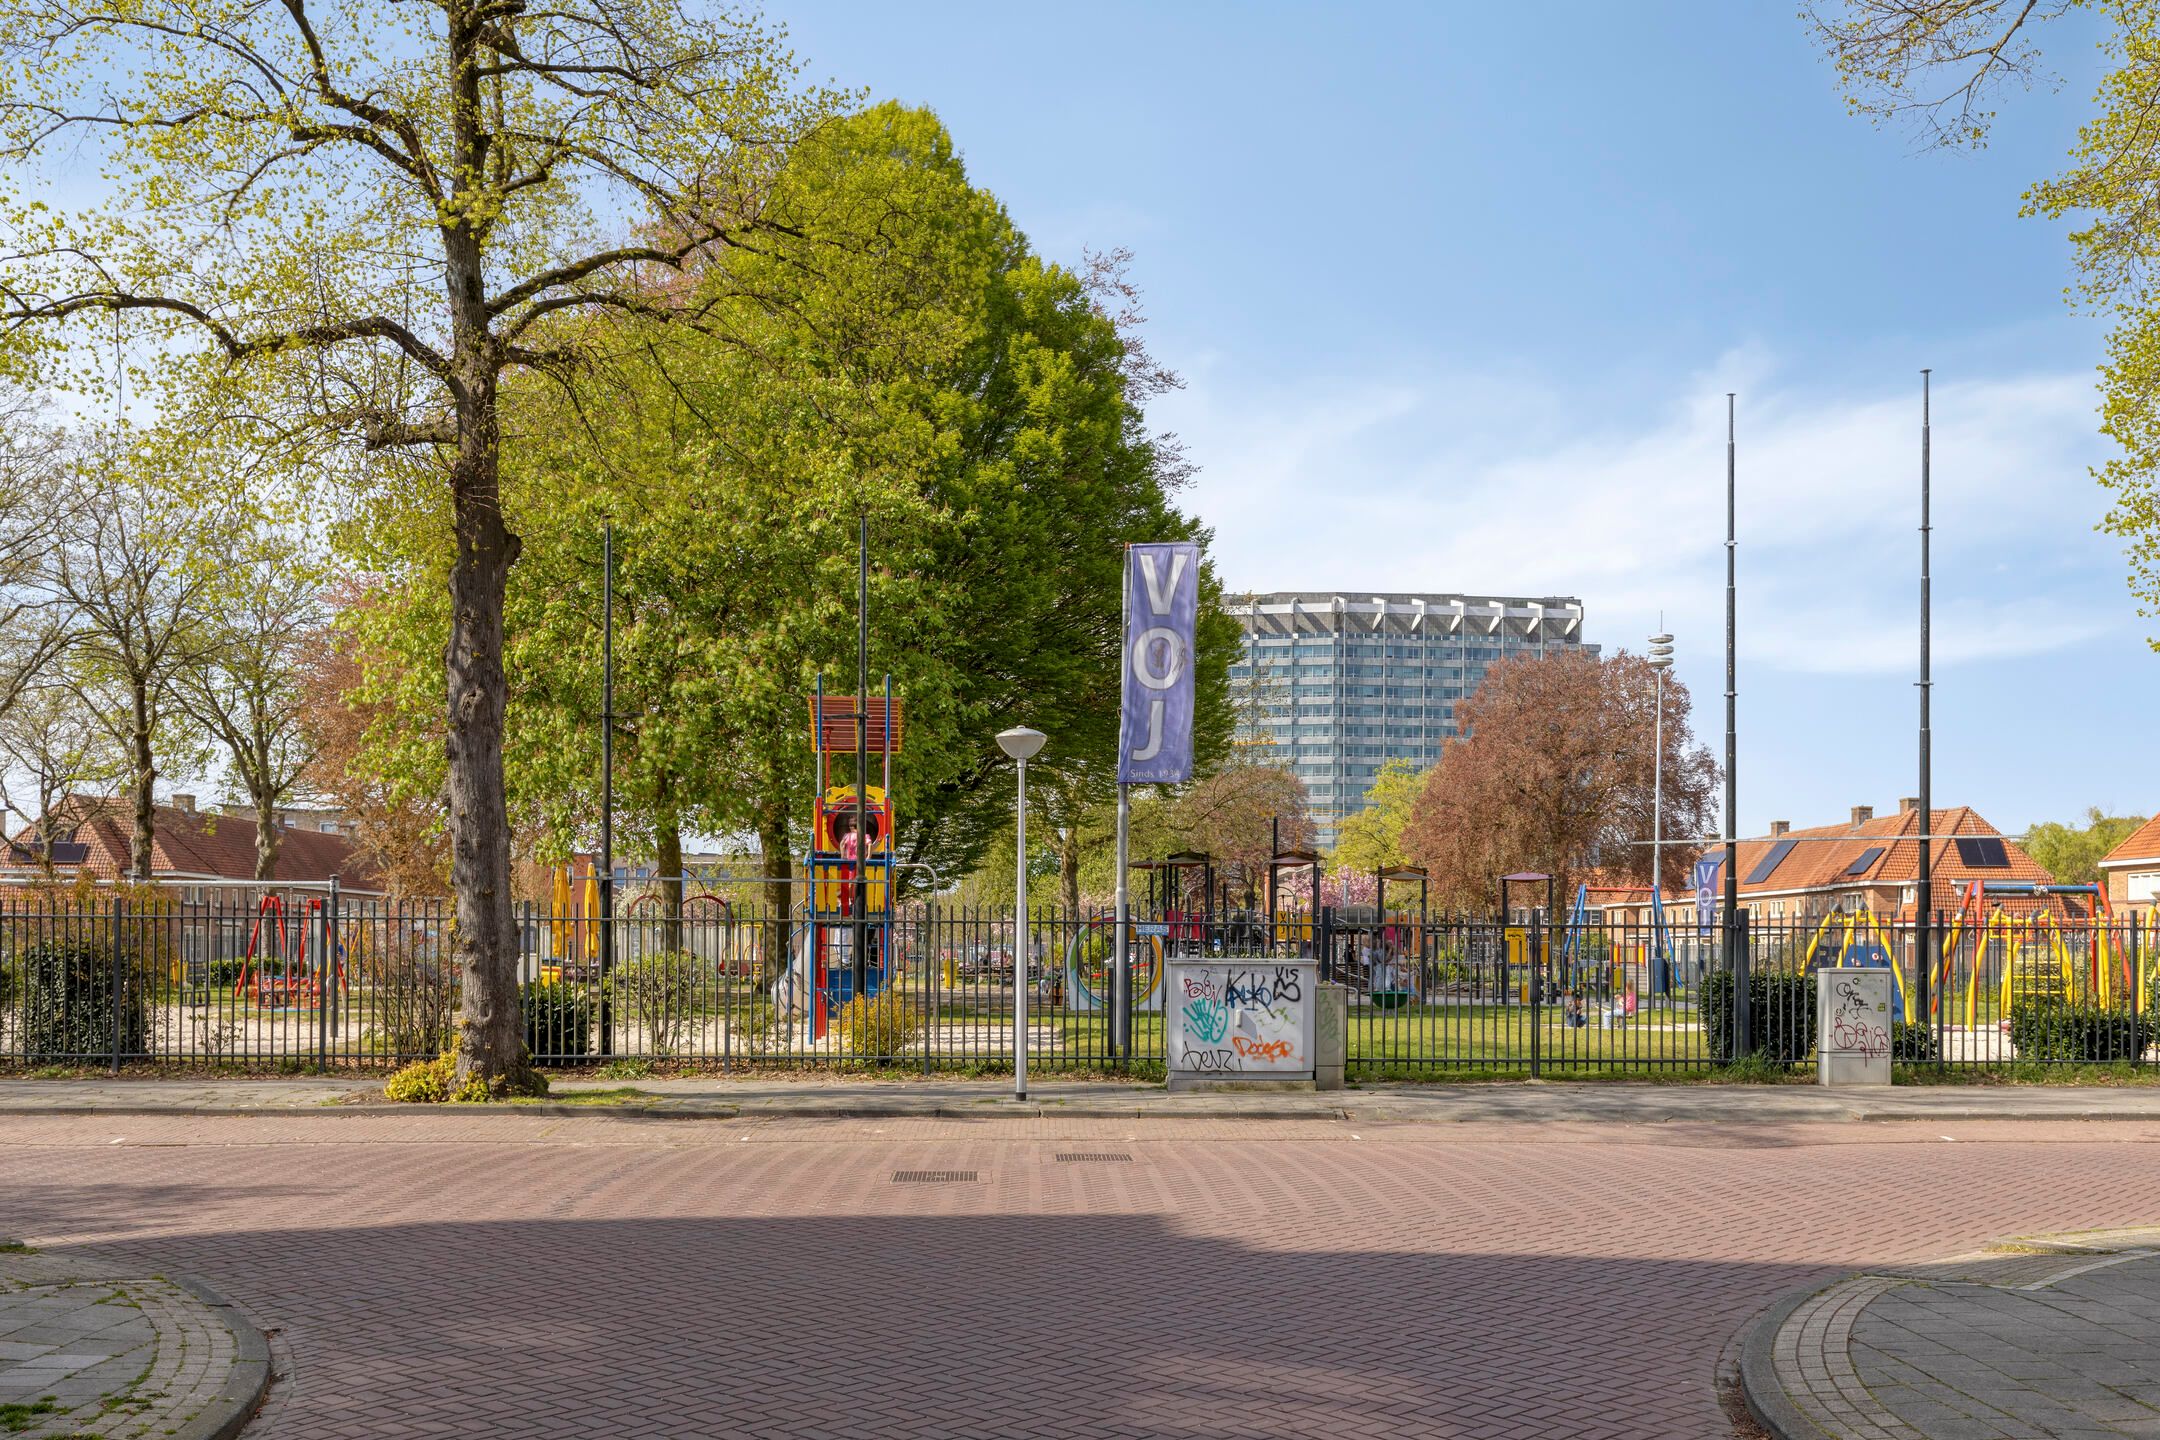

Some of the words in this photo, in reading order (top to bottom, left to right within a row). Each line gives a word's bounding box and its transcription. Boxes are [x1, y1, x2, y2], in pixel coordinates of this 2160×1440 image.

[1132, 553, 1188, 761] VOJ
[1130, 768, 1154, 778] Sinds
[1136, 924, 1168, 932] HERAS
